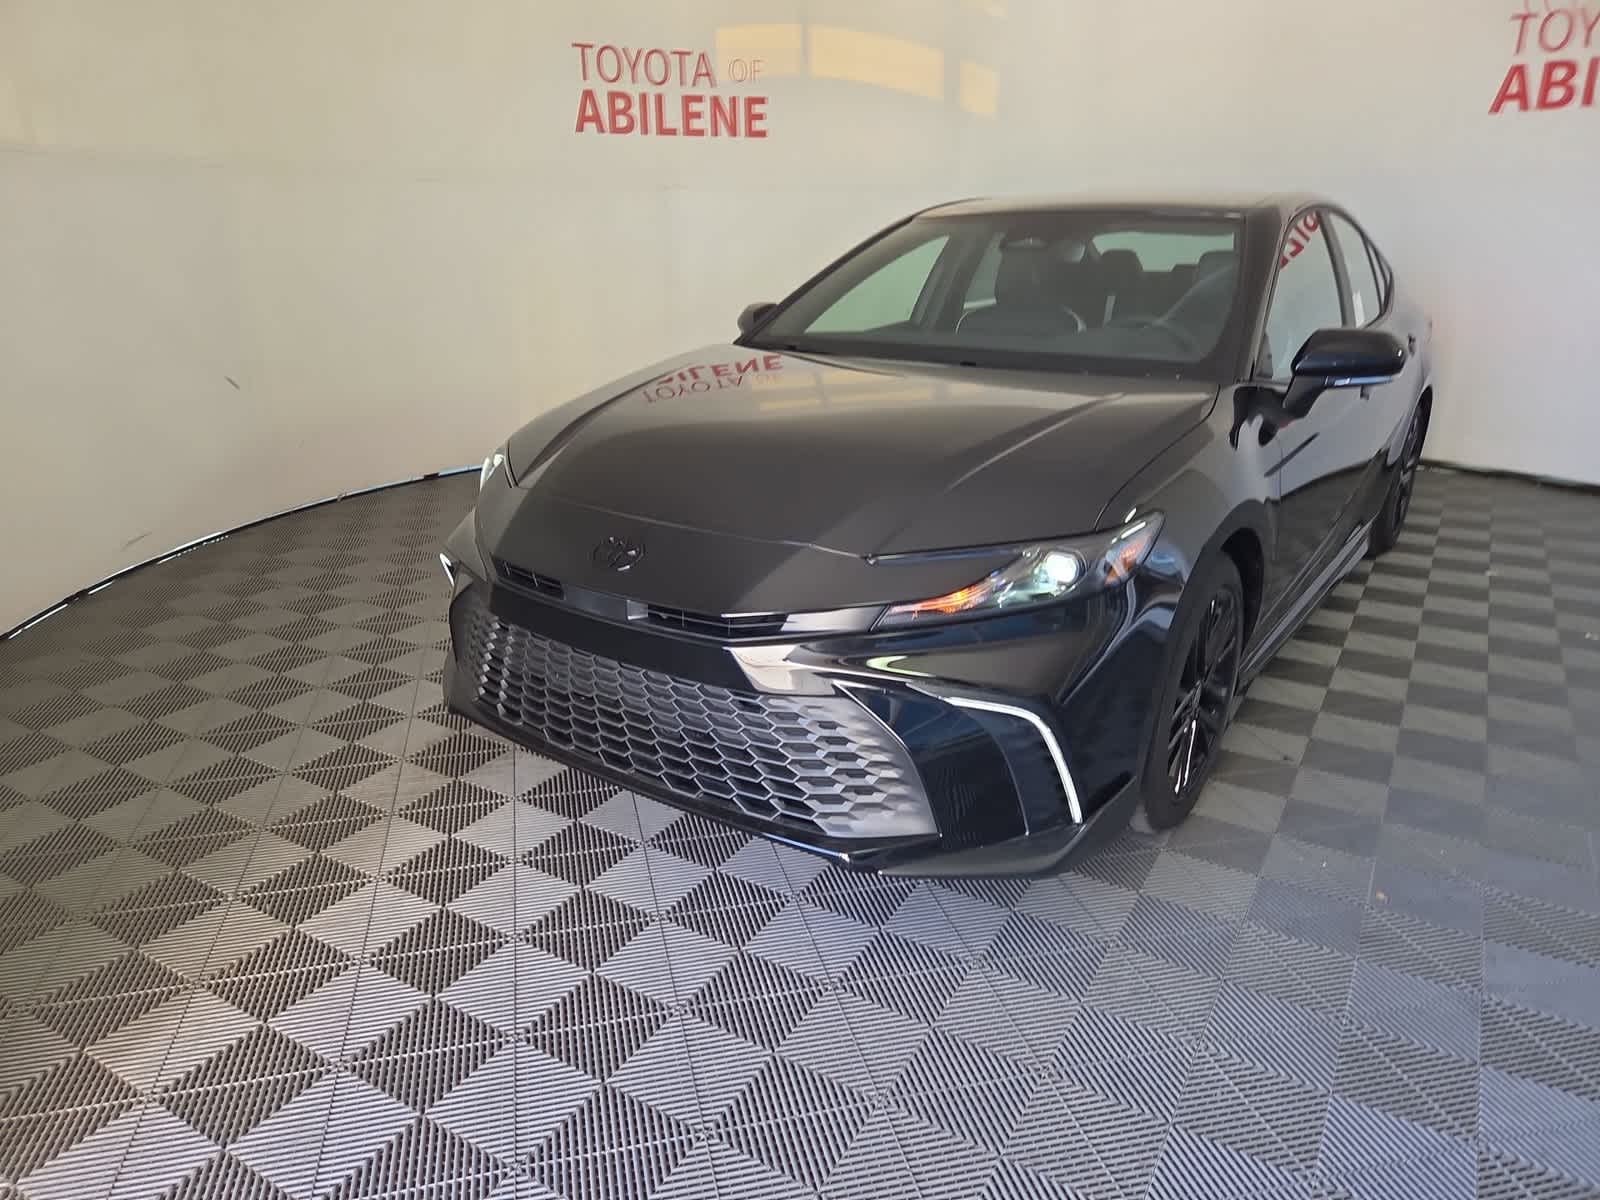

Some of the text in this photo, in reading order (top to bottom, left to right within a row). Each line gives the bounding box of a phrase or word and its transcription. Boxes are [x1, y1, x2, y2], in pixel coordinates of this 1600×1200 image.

[571, 43, 764, 88] TOYOTA OF
[575, 89, 768, 138] ABILENE
